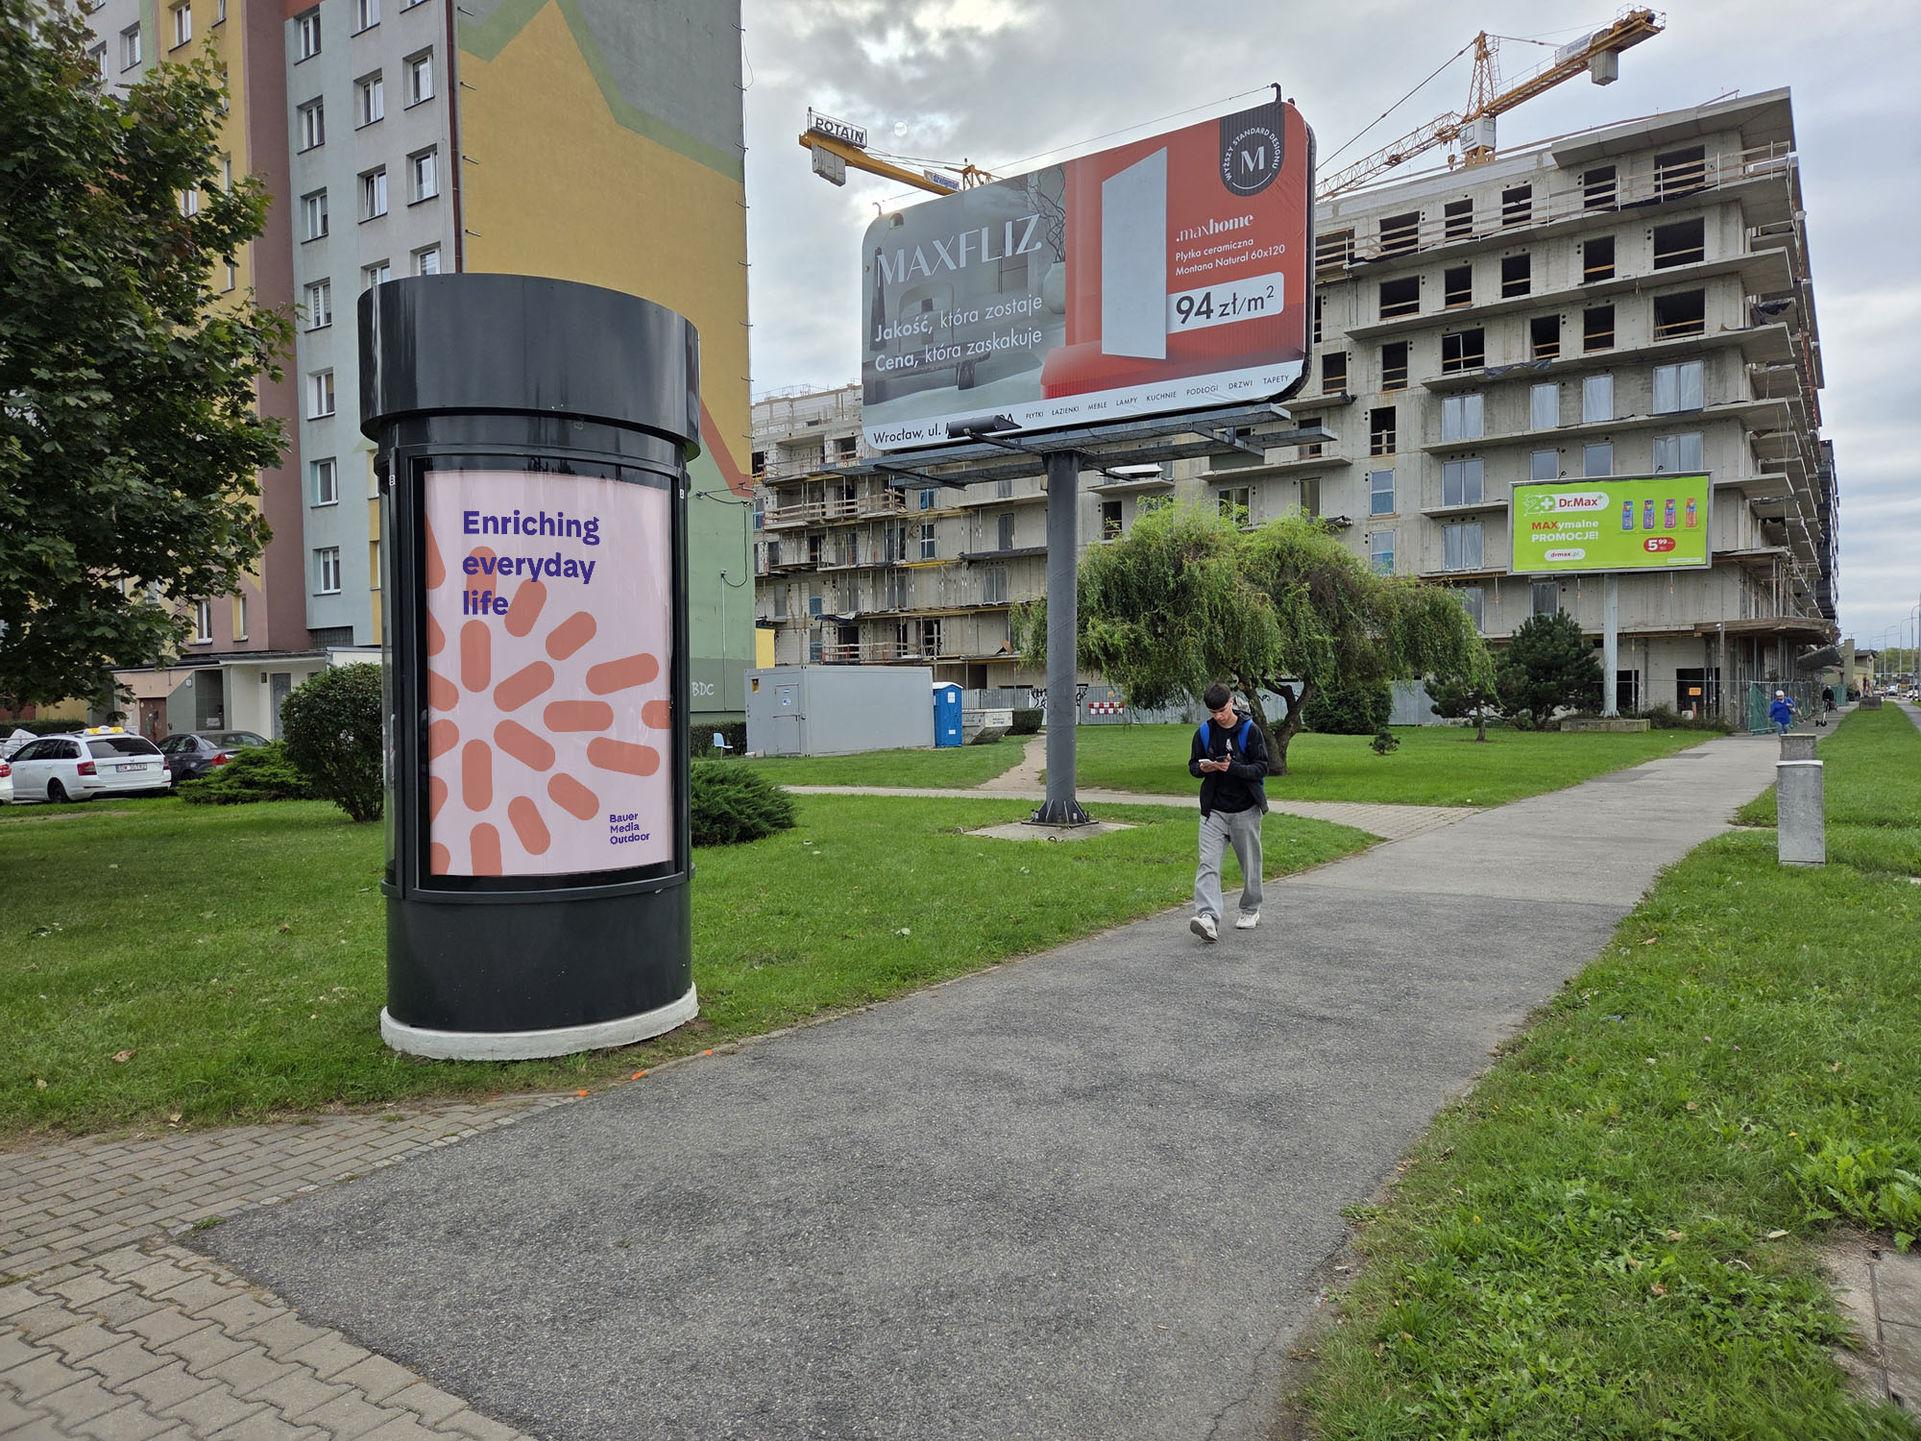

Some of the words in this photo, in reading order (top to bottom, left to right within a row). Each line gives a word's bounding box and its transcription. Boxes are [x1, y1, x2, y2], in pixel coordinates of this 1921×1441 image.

[815, 117, 865, 144] POTAIN
[1232, 127, 1270, 146] STANDARD
[1240, 145, 1265, 175] M
[876, 213, 1043, 288] MAXFLIZ
[1175, 262, 1213, 276] Montana
[1215, 252, 1249, 268] Natural
[1251, 244, 1286, 260] 60x120
[1203, 238, 1254, 256] ceramiczna
[875, 315, 933, 342] Jakość,
[940, 308, 979, 329] która
[985, 294, 1042, 317] zostaje
[1176, 291, 1214, 324] 94
[875, 353, 919, 372] Cena,
[925, 343, 961, 363] która
[967, 327, 1042, 350] zaskakuje
[1087, 401, 1107, 411] MEBLE
[1116, 396, 1138, 407] LAMPY
[1146, 391, 1177, 402] KUCHNIE
[1186, 385, 1219, 396] PODŁOGI
[1228, 379, 1253, 390] DRZWI
[1263, 374, 1290, 385] TAPETY
[873, 428, 924, 445] Wrocław,
[928, 423, 942, 437] ul.
[463, 509, 600, 546] Enriching
[1531, 519, 1600, 532] MAXymalne
[1531, 531, 1599, 543] PROMOCJE!
[462, 552, 596, 585] everyday
[463, 590, 509, 615] life
[609, 812, 638, 823] Bauer
[610, 822, 640, 834] Media
[610, 832, 650, 845] Outdoor
